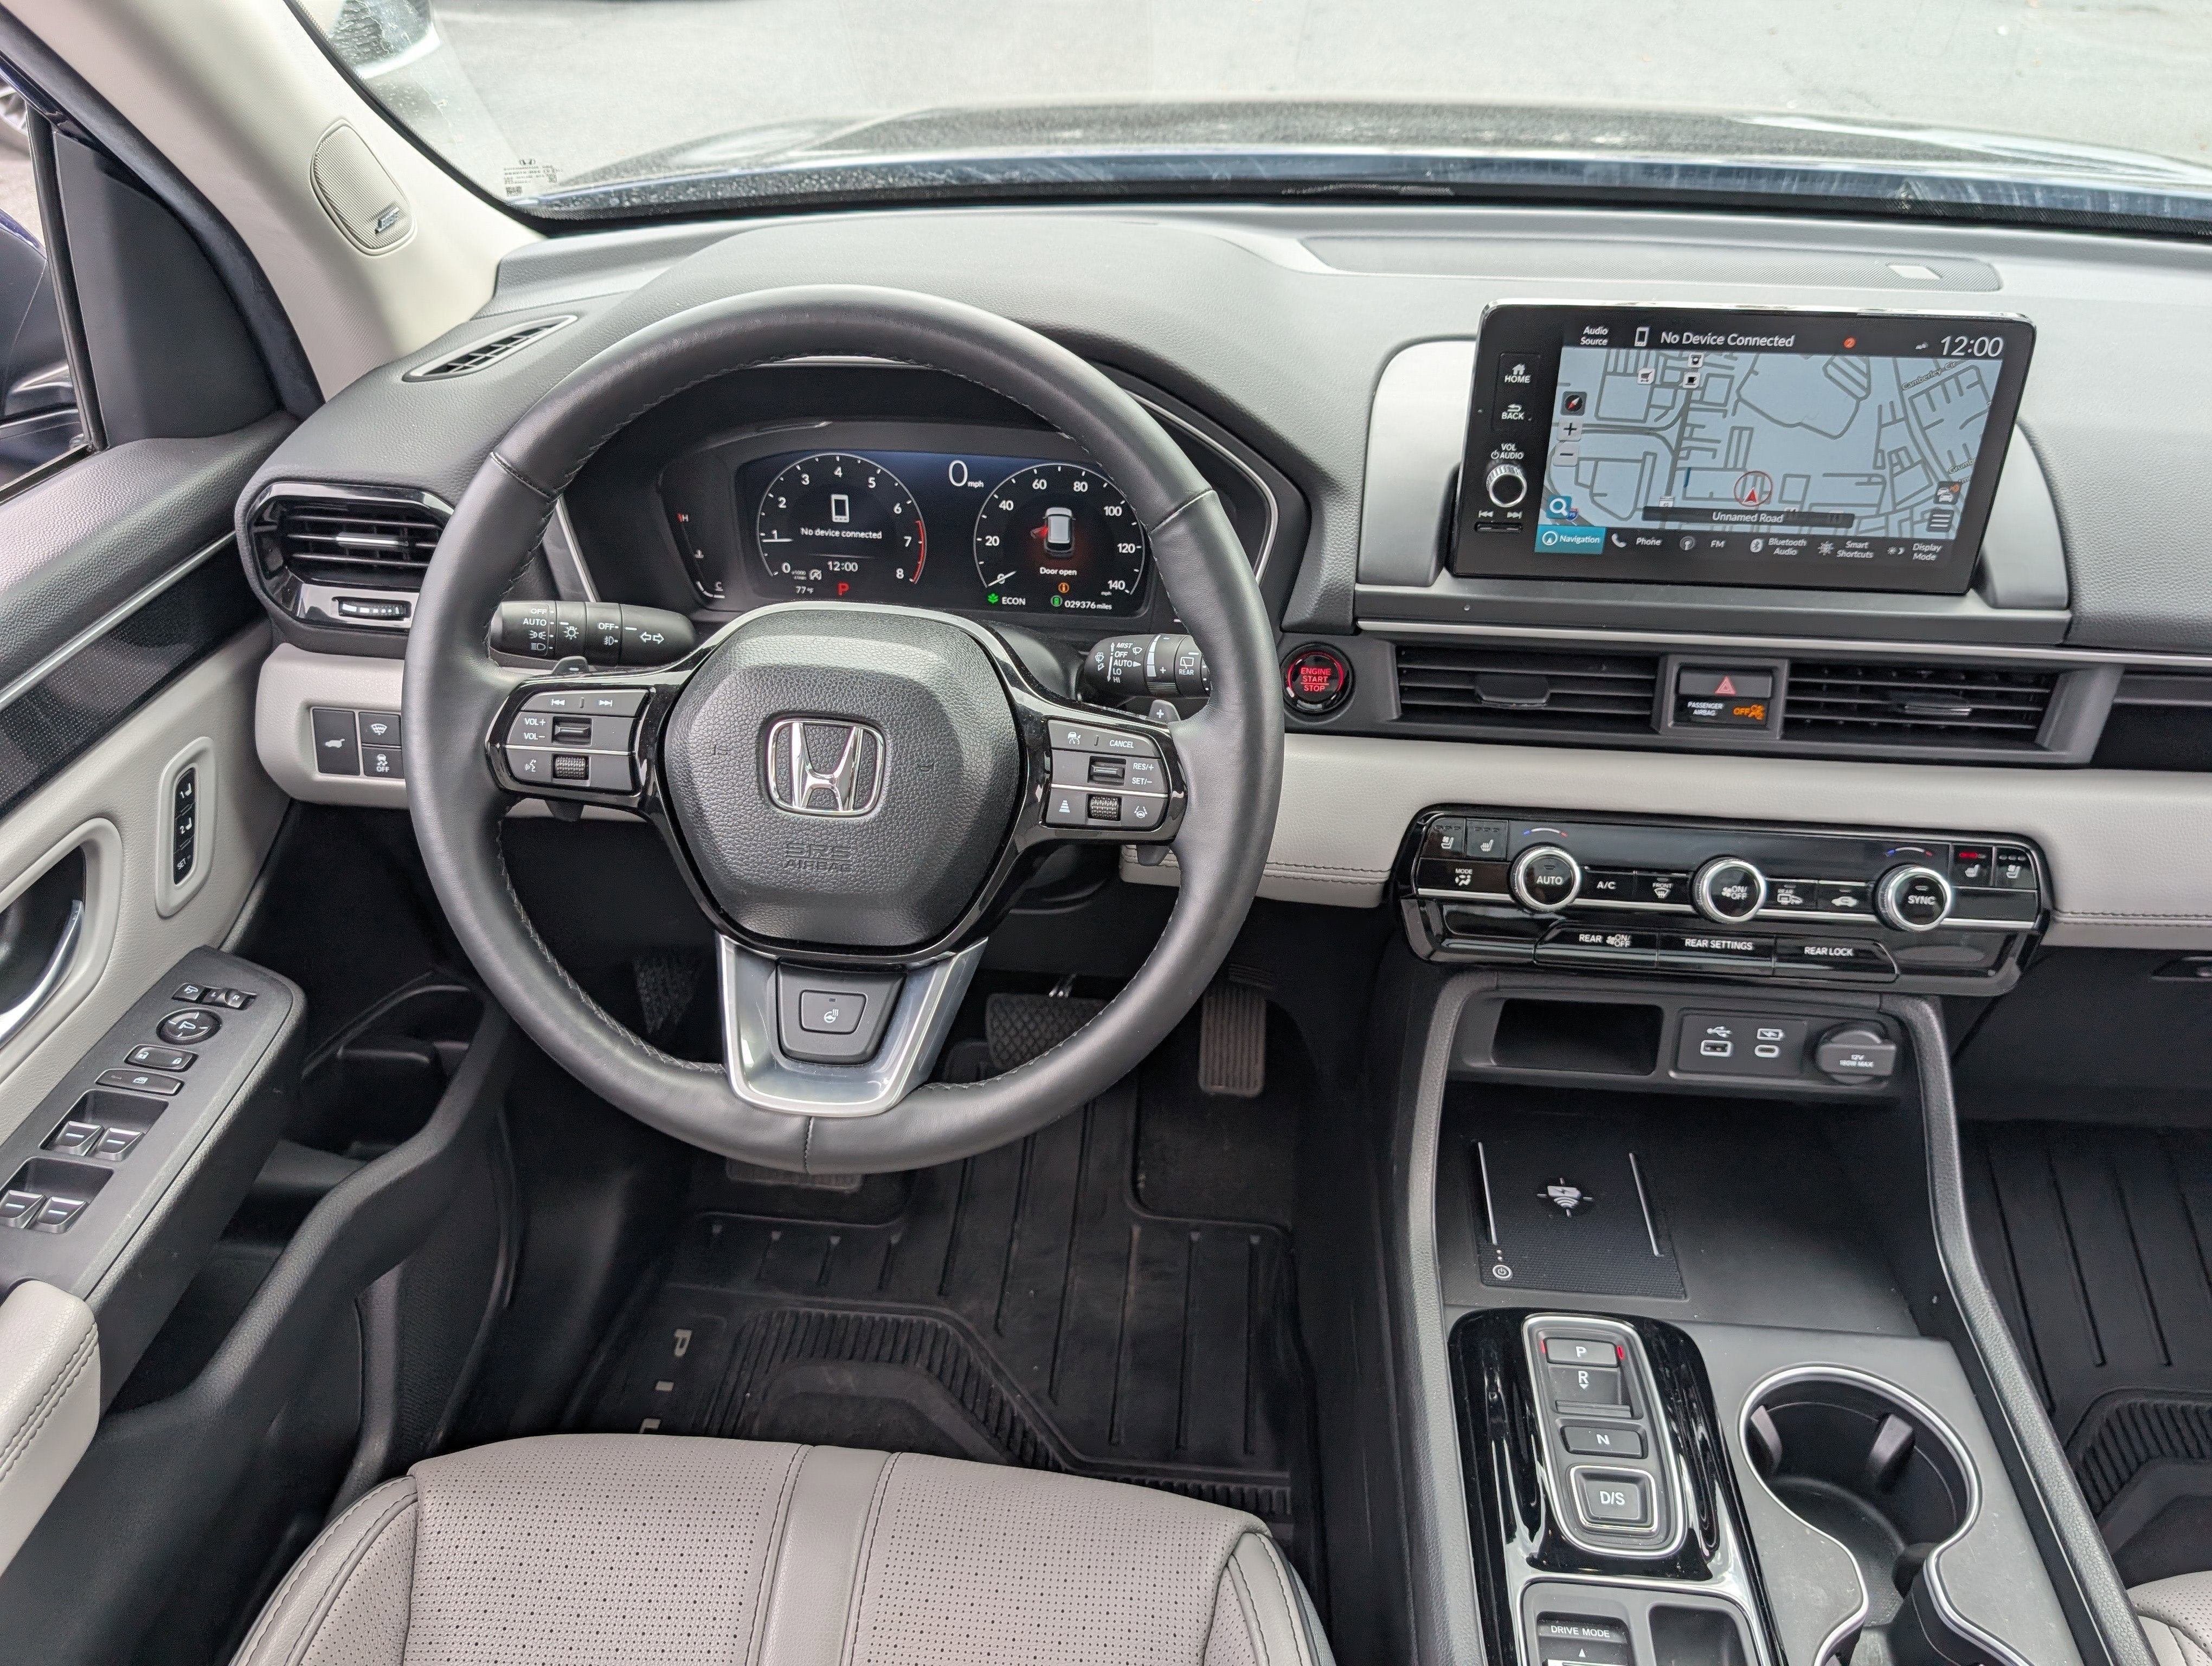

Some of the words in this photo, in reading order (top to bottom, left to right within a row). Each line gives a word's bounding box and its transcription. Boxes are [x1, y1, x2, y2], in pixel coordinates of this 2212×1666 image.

[1583, 326, 1609, 335] Audio
[1580, 337, 1608, 346] Source
[1661, 331, 1680, 344] No
[1682, 332, 1724, 345] Device
[1727, 334, 1795, 348] Connected
[1941, 336, 2003, 357] 12:00
[1504, 374, 1531, 383] HOME
[1902, 369, 1941, 390] Camberley
[1945, 361, 1956, 370] Cir
[1501, 412, 1525, 420] BACK
[1501, 443, 1517, 451] VOL
[1500, 451, 1525, 459] AUDIO
[834, 466, 843, 478] 4
[949, 460, 968, 486] 0
[968, 480, 984, 488] mph
[801, 473, 810, 485] 3
[868, 476, 876, 488] 5
[1032, 479, 1047, 490] 60
[1073, 481, 1088, 492] 80
[777, 497, 787, 508] 2
[999, 500, 1014, 511] 40
[893, 503, 902, 514] 6
[1103, 505, 1122, 516] 100
[1713, 511, 1758, 522] Unnamed
[1759, 513, 1784, 523] Road
[771, 530, 777, 540] 1
[800, 527, 813, 536] No
[814, 528, 840, 537] device
[841, 530, 883, 539] connected
[904, 536, 912, 547] 7
[985, 536, 1000, 546] 20
[1559, 535, 1600, 543] Navigation
[1636, 537, 1662, 546] Phone
[1768, 537, 1807, 547] Bluetooth
[1117, 543, 1135, 554] 120
[1846, 541, 1869, 549] Smart
[1913, 543, 1942, 552] Display
[1836, 550, 1874, 558] Shortcuts
[1913, 553, 1937, 561] Mode
[781, 562, 791, 573] 0
[827, 561, 859, 572] 12:00
[1039, 567, 1058, 575] Door
[896, 568, 904, 579] 8
[837, 582, 850, 595] P
[1108, 580, 1126, 590] 140
[1002, 597, 1026, 606] ECON
[1064, 600, 1096, 610] 029376
[1096, 602, 1113, 610] miles
[1301, 667, 1332, 676] ENGINE
[1687, 701, 1724, 709] PASSENGER
[1733, 707, 1751, 716] OFF
[1109, 740, 1134, 748] CANCEL
[176, 857, 187, 870] SET
[1536, 875, 1564, 886] AUTO
[1597, 881, 1617, 889] A/C
[1731, 885, 1748, 894] ON/
[1907, 895, 1936, 906] SYNC
[1579, 933, 1603, 943] REAR
[1684, 938, 1708, 947] REAR
[1710, 939, 1753, 951] SETTINGS
[1804, 946, 1828, 956] REAR
[1829, 948, 1854, 957] LOCK
[1576, 1346, 1586, 1357] P
[1578, 1370, 1589, 1384] R
[1596, 1433, 1610, 1446] N
[1599, 1490, 1625, 1505] D/S
[1551, 1625, 1579, 1636] DRIVE
[1582, 1627, 1610, 1638] MODE
